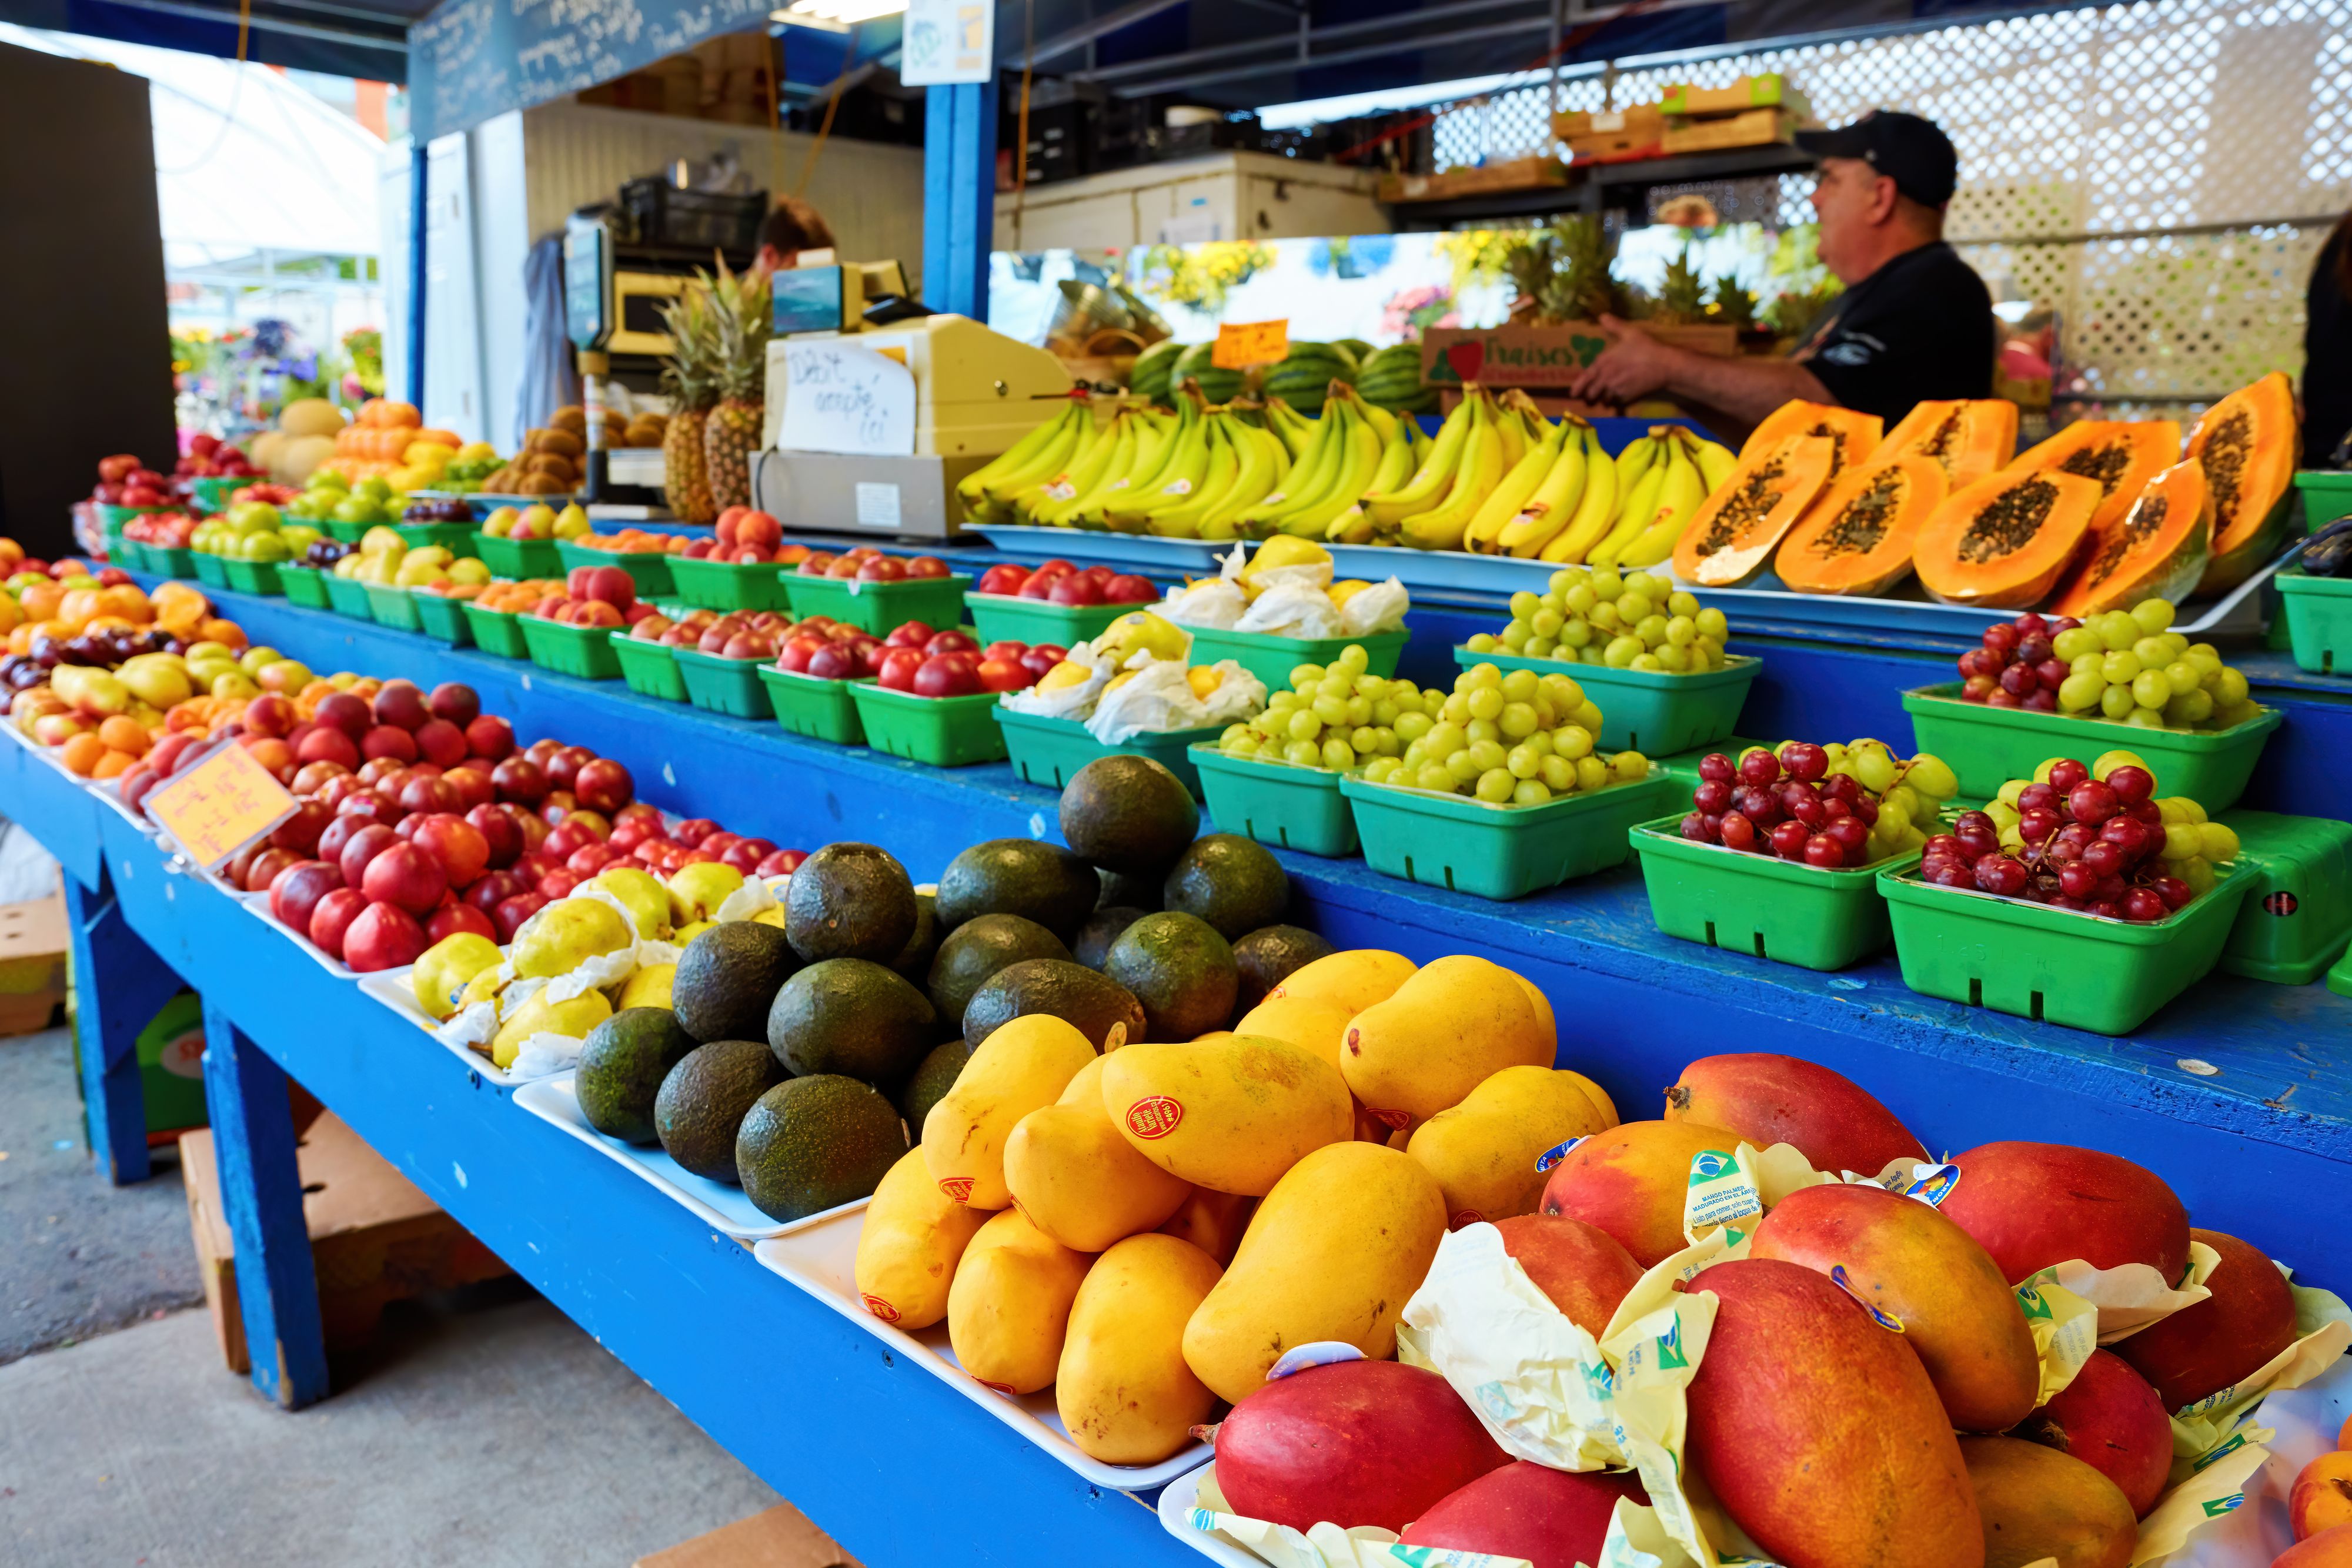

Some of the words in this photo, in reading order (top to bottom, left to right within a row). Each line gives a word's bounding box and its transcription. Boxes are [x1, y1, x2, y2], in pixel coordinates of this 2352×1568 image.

[1131, 1112, 1148, 1133] Ataulfo
[1161, 1103, 1175, 1122] #4961
[1702, 1192, 1723, 1202] MANGO
[1722, 1185, 1745, 1196] PALMER
[1931, 1182, 1950, 1203] AROM
[1693, 1197, 1724, 1212] MADURADO
[1693, 1214, 1705, 1224] Listo
[1705, 1211, 1716, 1221] para
[1731, 1201, 1742, 1209] solo
